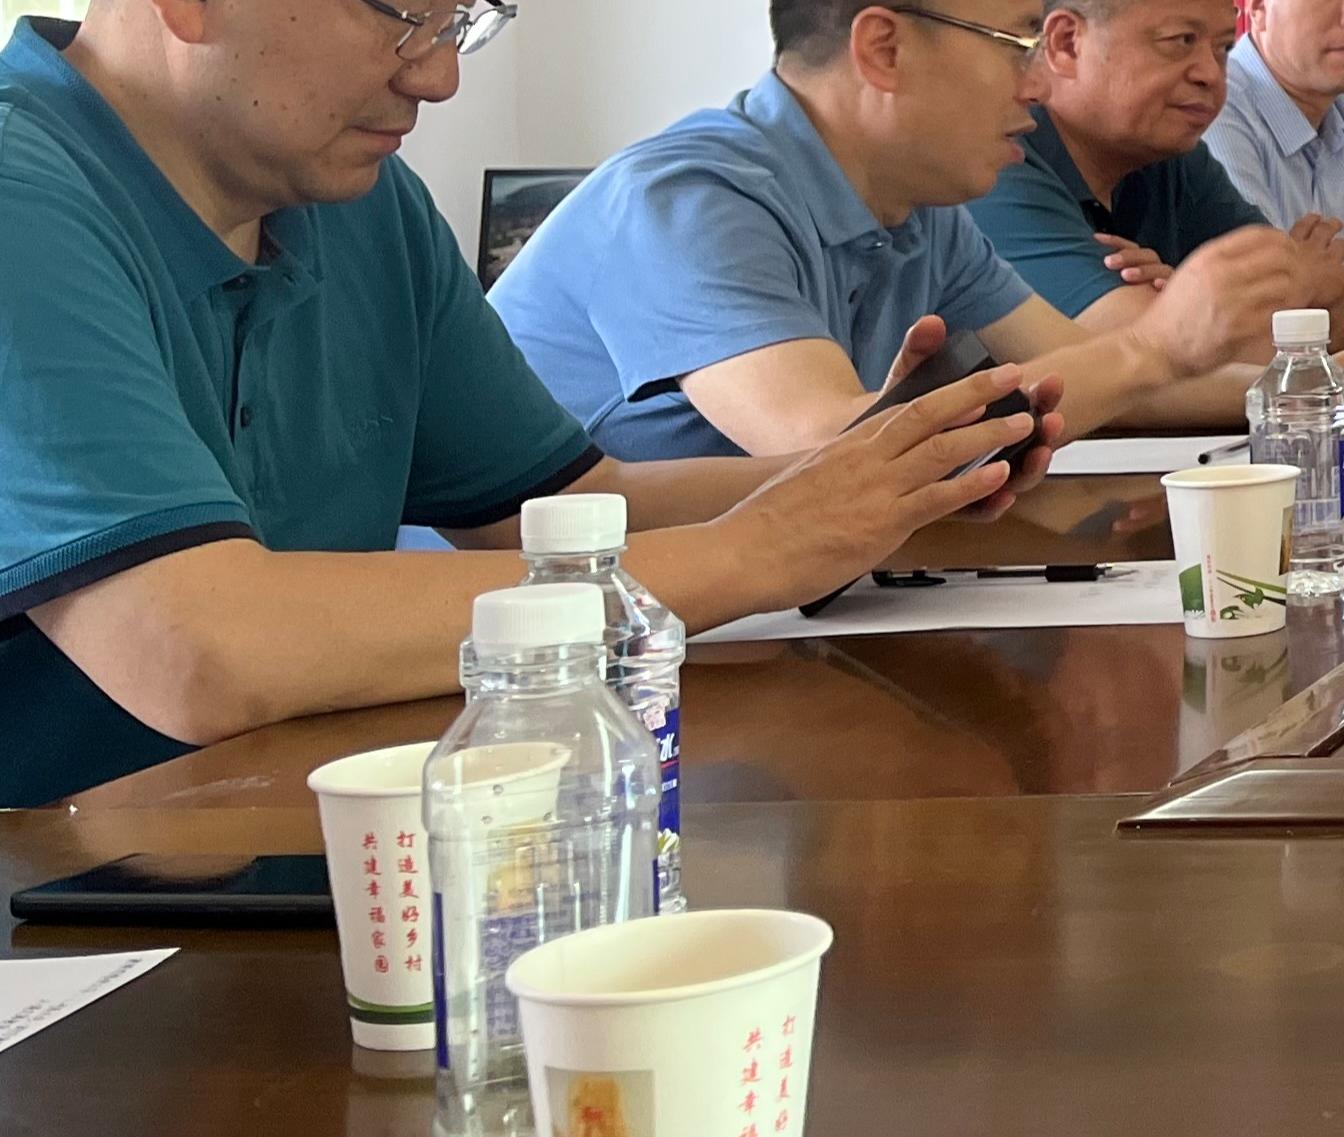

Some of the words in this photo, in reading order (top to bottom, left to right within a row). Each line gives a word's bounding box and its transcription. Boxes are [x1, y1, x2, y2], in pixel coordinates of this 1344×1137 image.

[361, 831, 391, 975] 共建幸福家园
[396, 830, 424, 973] 打造美好乡村
